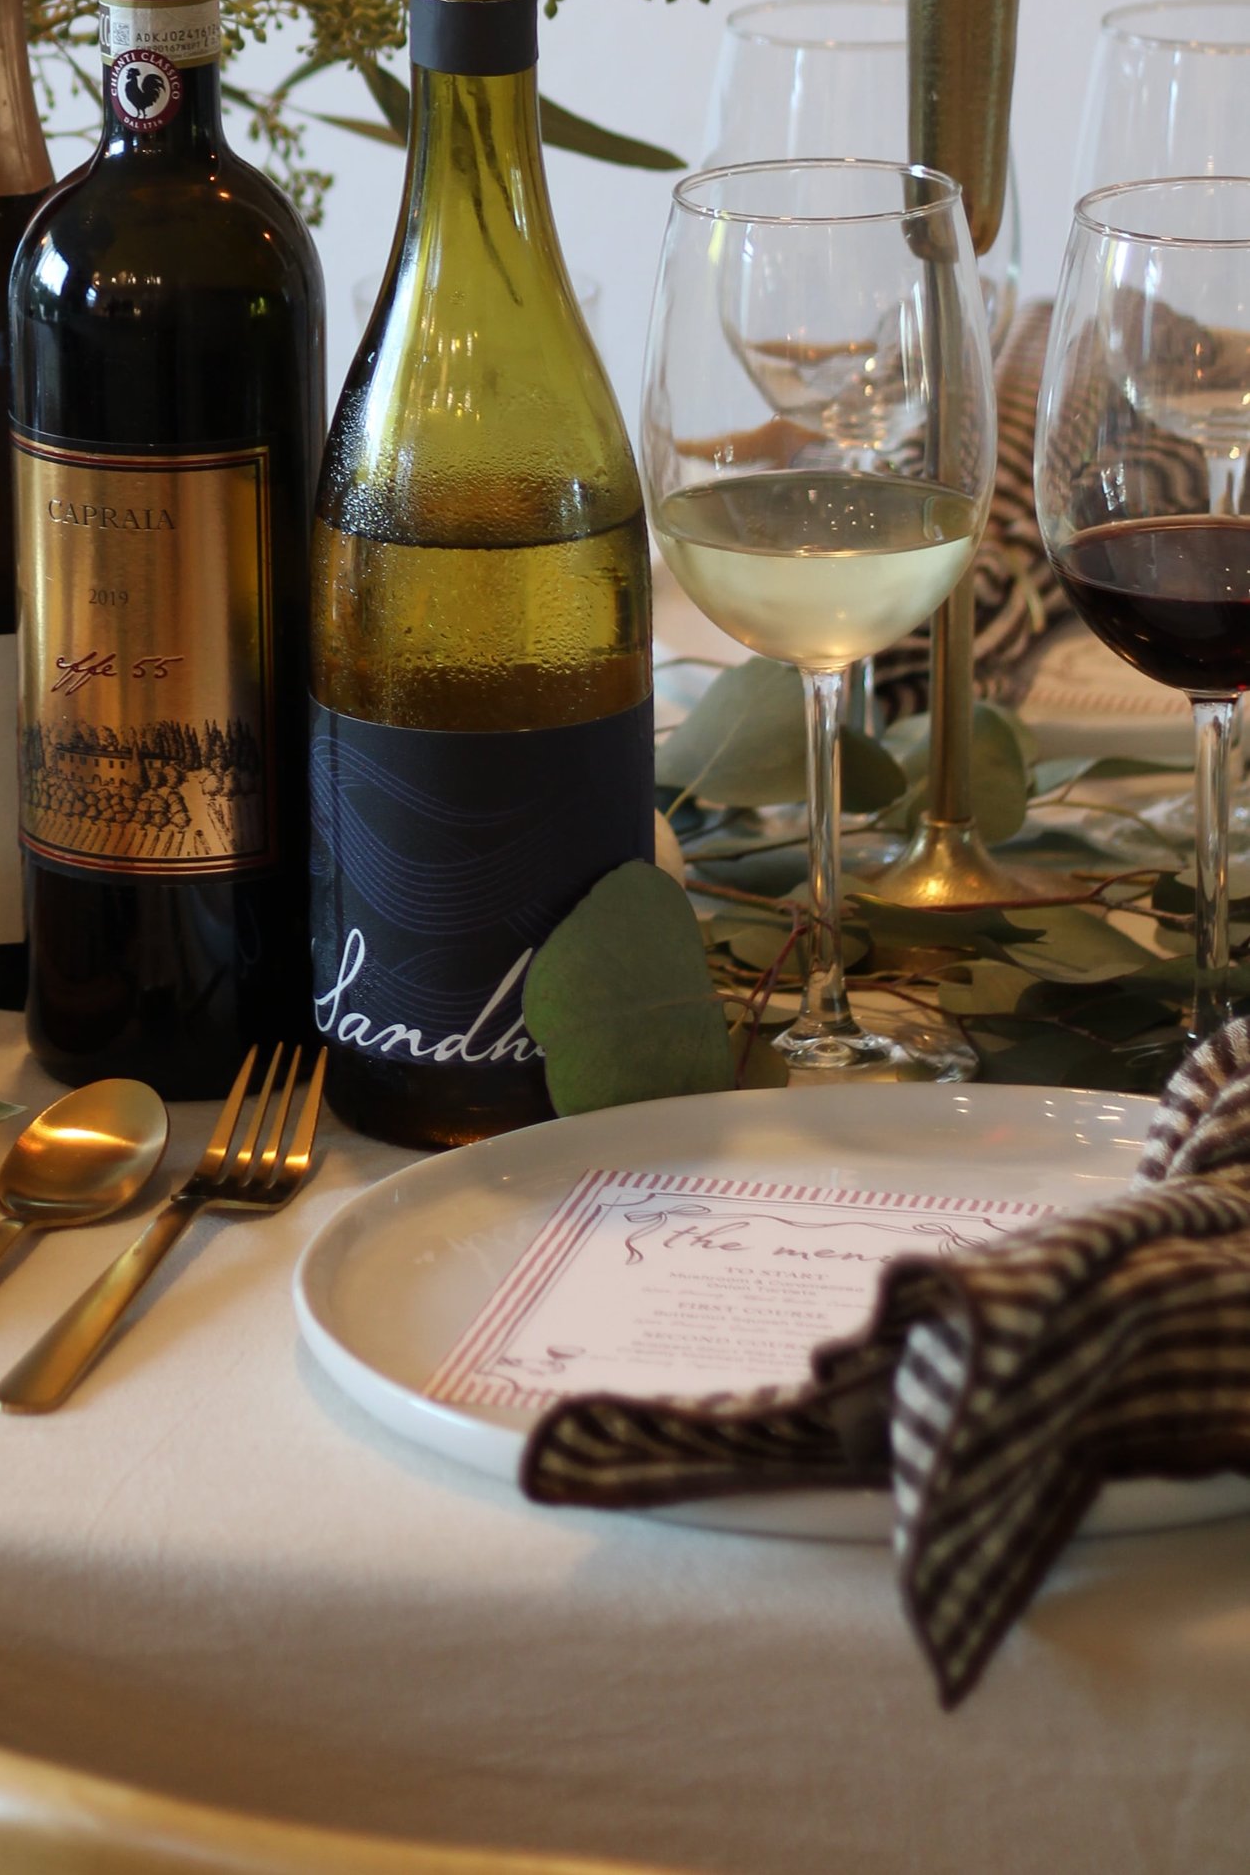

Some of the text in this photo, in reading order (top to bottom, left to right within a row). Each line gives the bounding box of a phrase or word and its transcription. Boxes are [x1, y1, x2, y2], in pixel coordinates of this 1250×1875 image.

[110, 52, 181, 99] CHIANTI CLASSICO
[48, 498, 176, 530] CAPRAIA
[88, 589, 129, 606] 2019
[51, 651, 184, 696] effe 55
[311, 928, 547, 1063] Sandh
[663, 1221, 751, 1252] the
[759, 1269, 830, 1281] START
